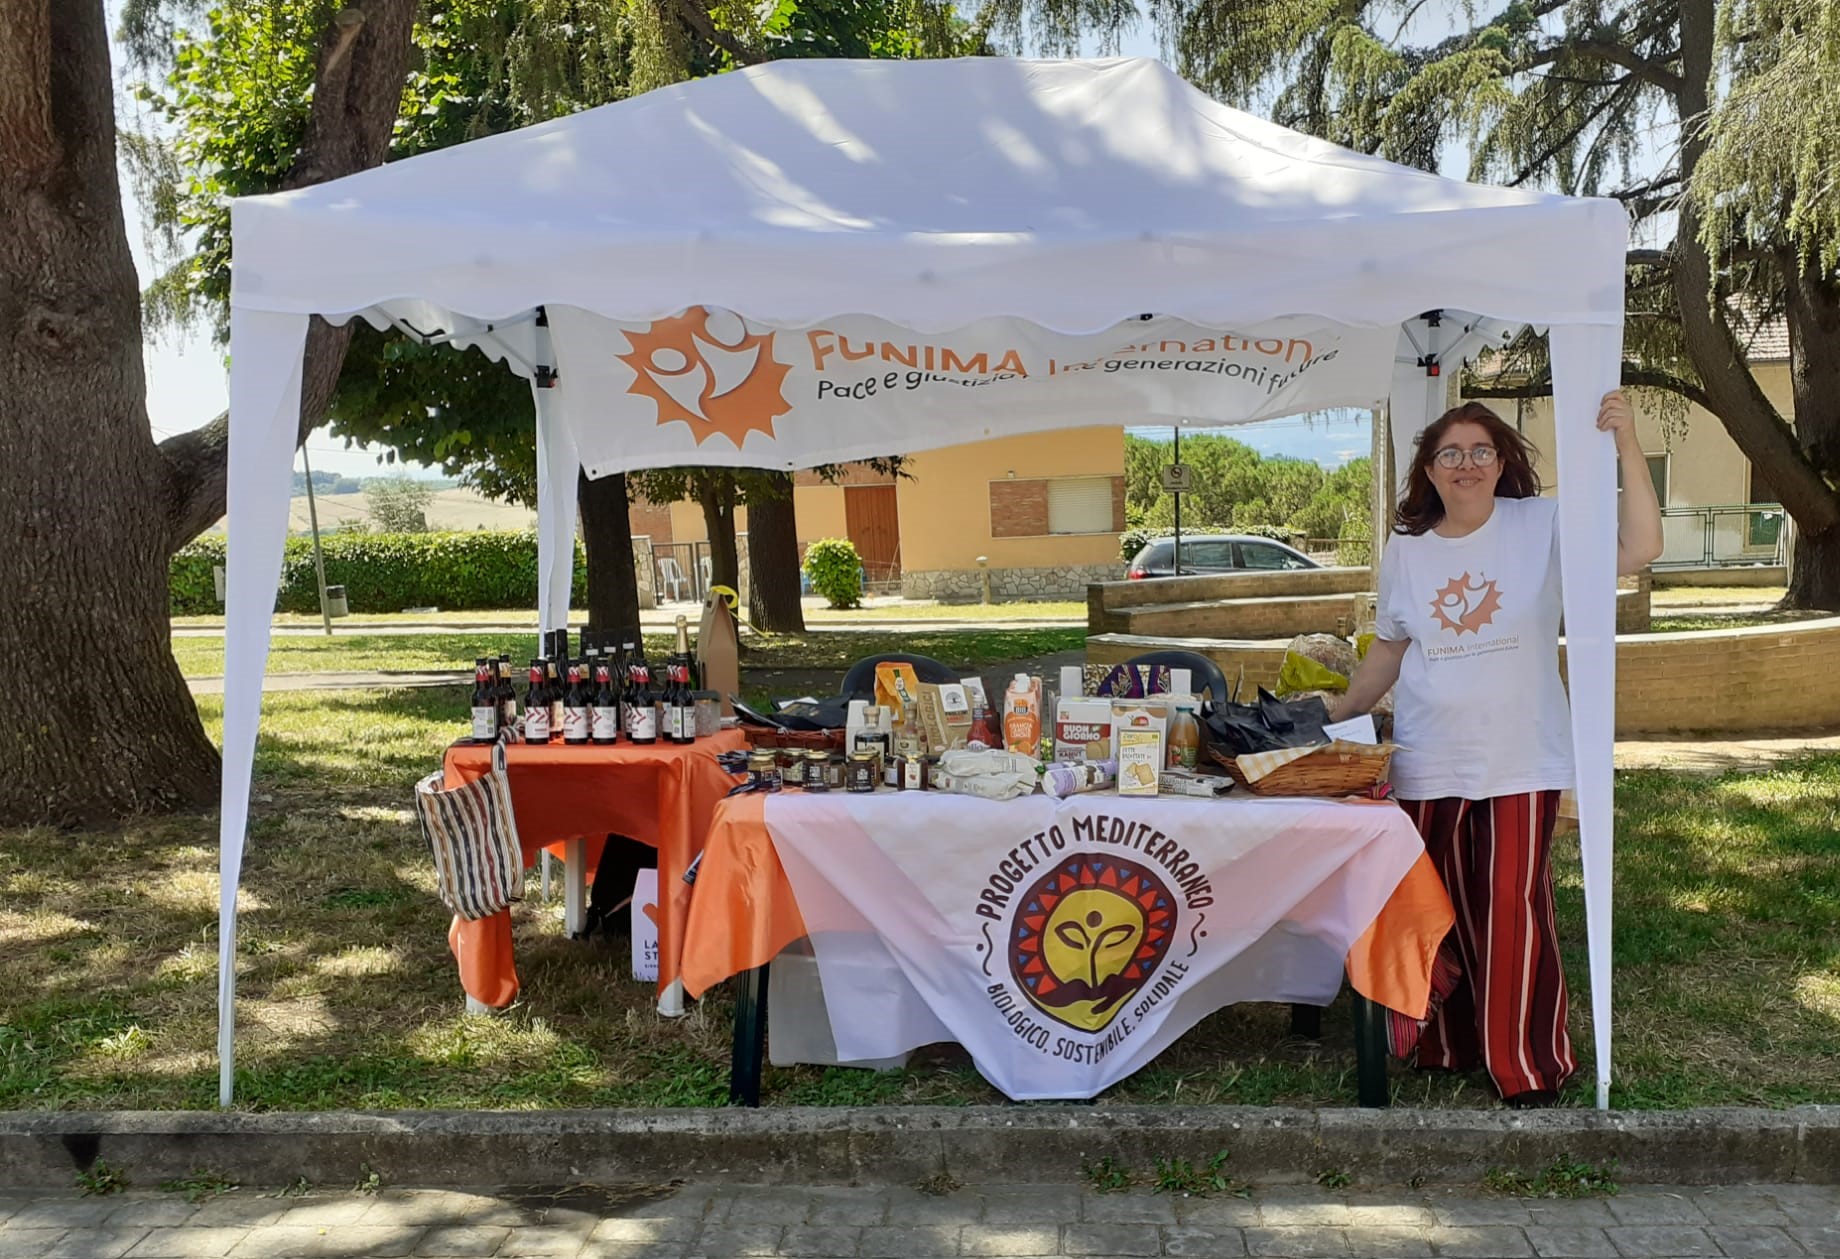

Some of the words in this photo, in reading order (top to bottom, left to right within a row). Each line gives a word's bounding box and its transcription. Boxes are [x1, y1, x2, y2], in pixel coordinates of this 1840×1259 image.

[807, 330, 1028, 376] FUNIMA
[818, 377, 877, 400] Pace
[883, 371, 898, 389] e
[1103, 358, 1268, 387] generazioni
[1427, 645, 1465, 657] FUNIMA
[1063, 724, 1090, 733] BUON
[1063, 731, 1101, 741] GIORNO
[976, 824, 1066, 921] PROGETTO
[1072, 815, 1215, 910] MEDITERRANEO
[987, 983, 1050, 1054] BIOLOGICO,
[1134, 960, 1189, 1022] SOLIDALE
